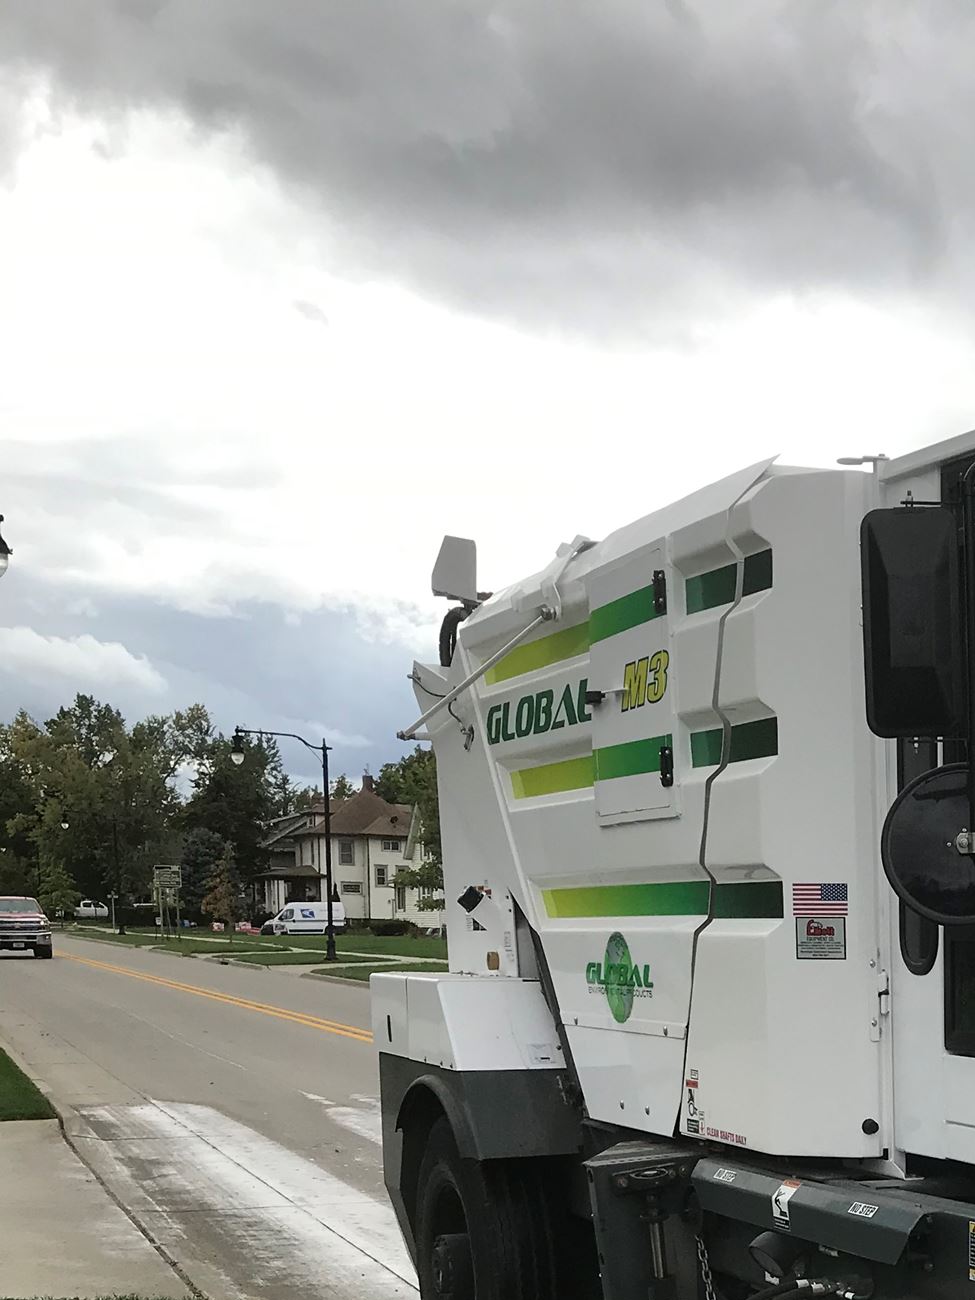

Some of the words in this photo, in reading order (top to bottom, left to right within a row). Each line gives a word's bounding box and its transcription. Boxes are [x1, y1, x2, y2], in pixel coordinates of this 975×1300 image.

[621, 649, 670, 712] M3
[486, 678, 592, 745] GLOBAL
[586, 962, 654, 988] GLOBAL
[859, 1205, 877, 1216] STEP
